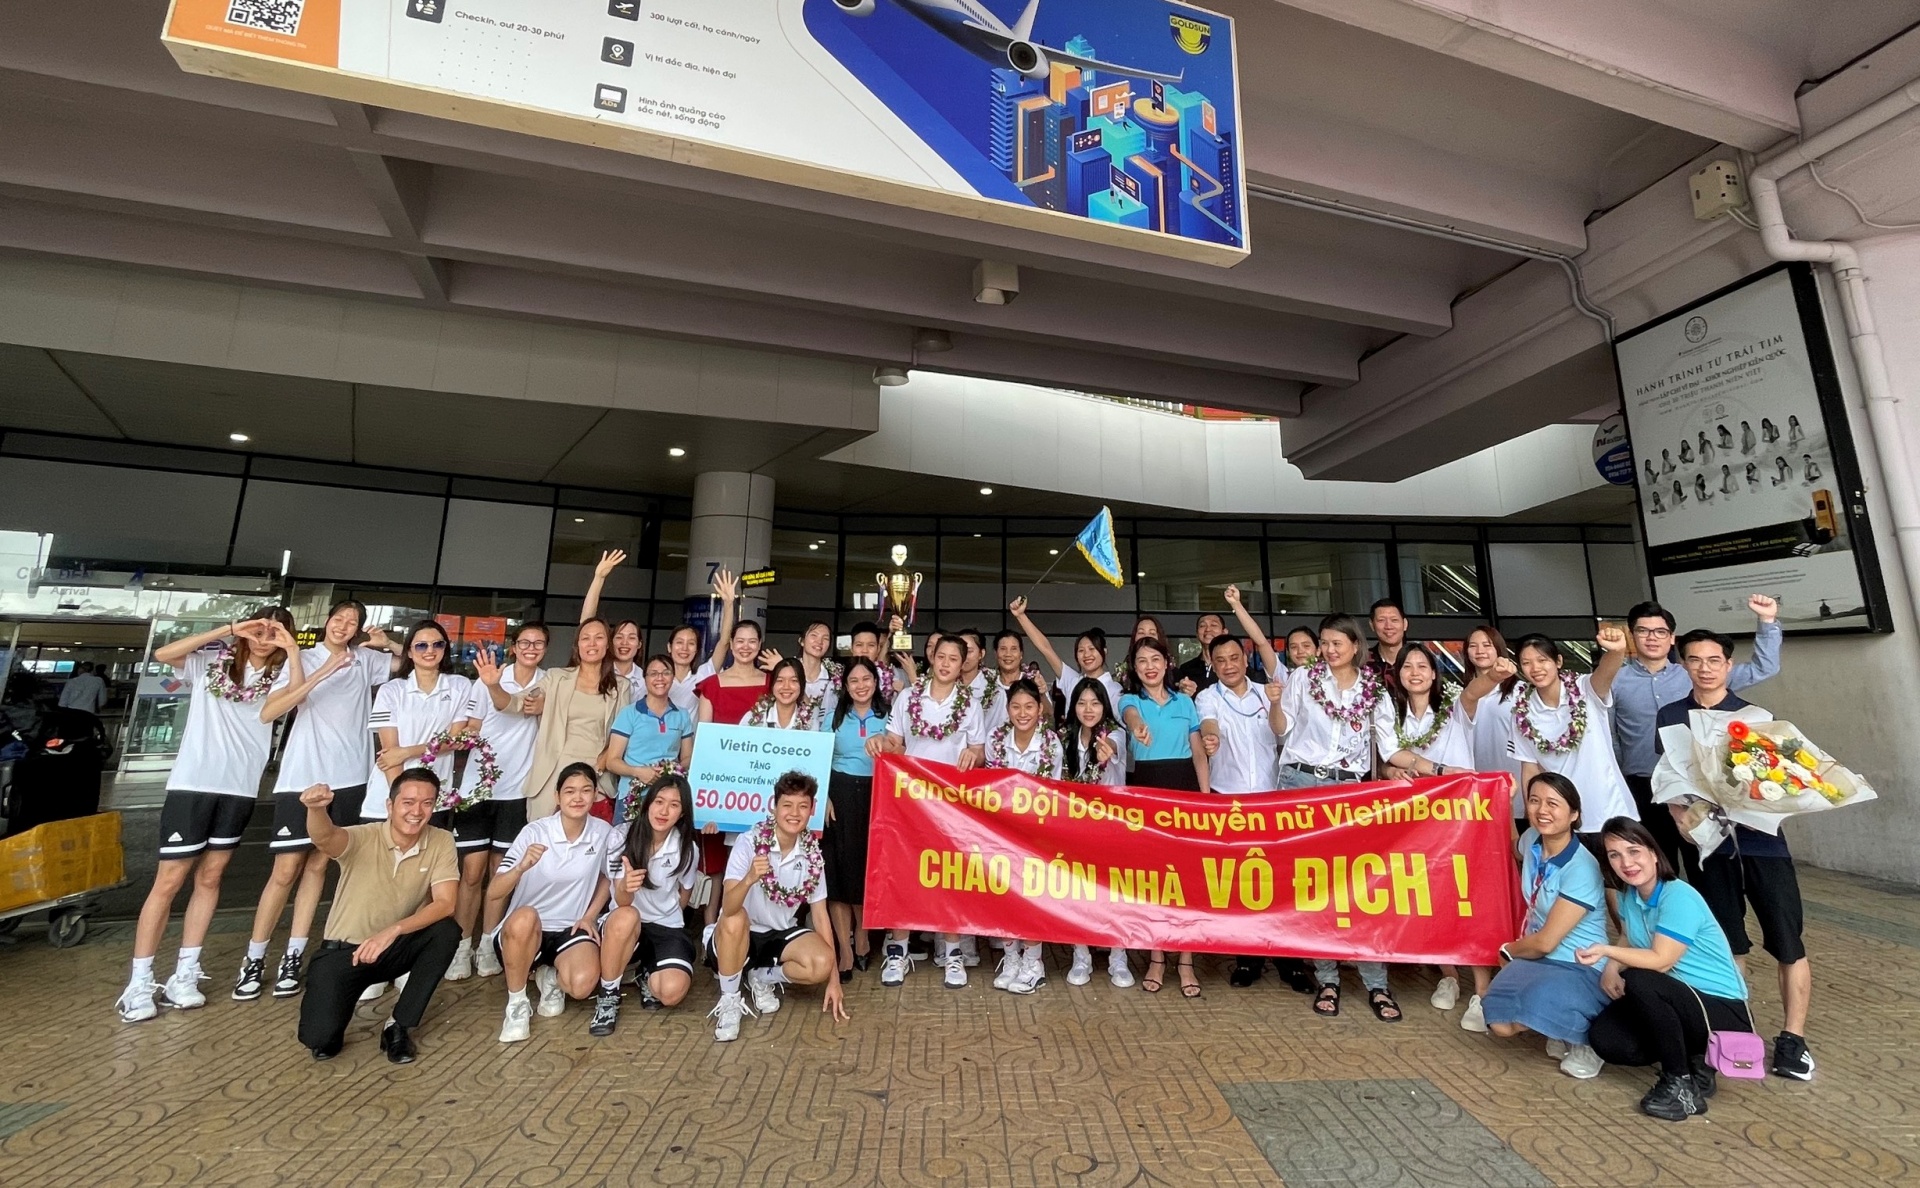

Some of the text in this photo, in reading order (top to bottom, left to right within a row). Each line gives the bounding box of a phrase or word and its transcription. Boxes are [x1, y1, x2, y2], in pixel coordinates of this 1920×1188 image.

[455, 10, 565, 40] Checkin, out 20-30 phút
[650, 12, 665, 21] 300
[702, 24, 714, 34] hạ
[715, 28, 761, 44] cánh/ngày
[1170, 17, 1210, 34] GOLDSUN
[645, 52, 653, 62] Vị
[702, 66, 720, 76] hiện
[722, 69, 737, 79] đại
[637, 105, 720, 129] sắc nét, sống động
[639, 96, 726, 121] Hình ảnh quảng cáo
[1636, 378, 1665, 397] HÀNH
[1668, 364, 1704, 385] TRÌNH
[1726, 344, 1755, 363] TRÁI
[1759, 334, 1784, 350] TIM
[706, 562, 720, 584] 7
[720, 738, 811, 757] Vietin Coseco
[700, 772, 714, 782] ĐỘI
[715, 772, 736, 783] BÓNG
[749, 760, 771, 772] TẶNG
[894, 771, 1494, 836] Fanclub Đội bóng chuyền nữ VietinBank
[918, 843, 1474, 929] CHÀO ĐÓN NHÀ VÔ ĐỊCH !
